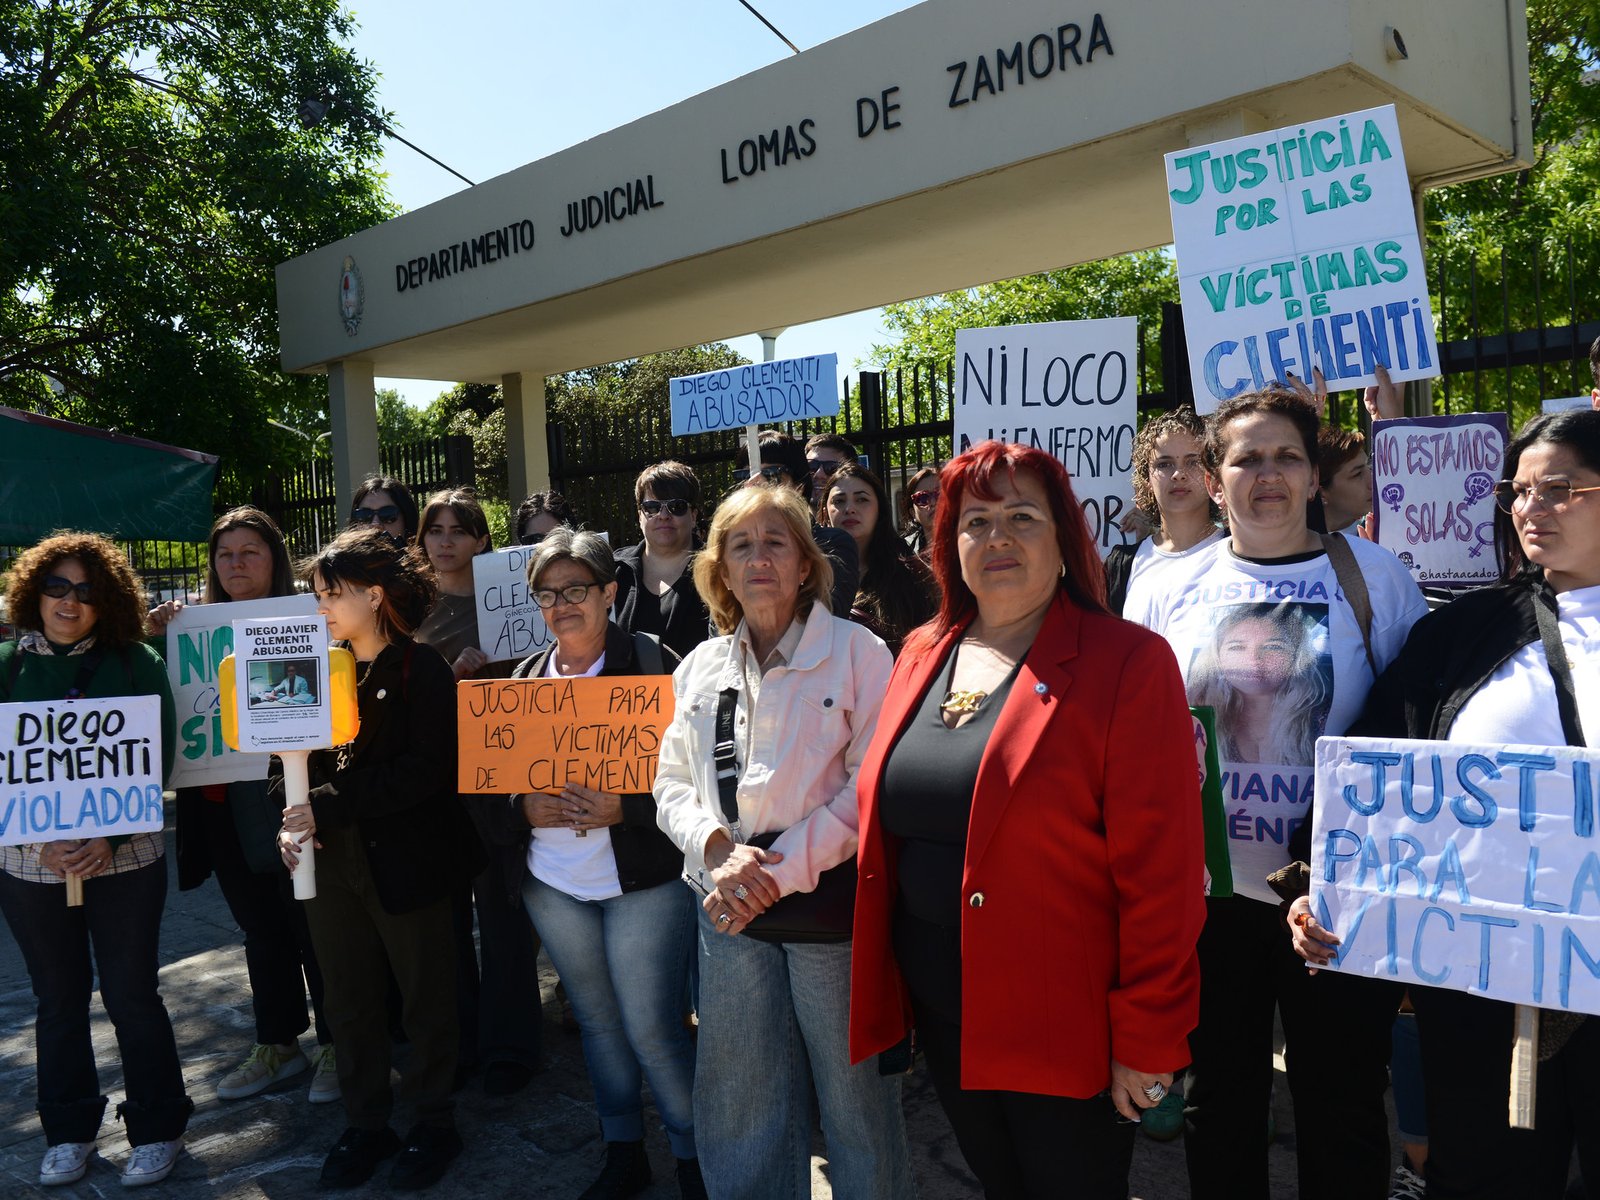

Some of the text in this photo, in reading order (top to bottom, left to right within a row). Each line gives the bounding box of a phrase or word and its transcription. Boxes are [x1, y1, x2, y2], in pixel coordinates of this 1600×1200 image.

[395, 13, 1114, 293] DEPARTAMENTO JUDICIAL LOMAS DE ZAMORA
[1214, 173, 1372, 236] POR LAS
[1284, 293, 1332, 321] DE
[679, 357, 820, 396] DIEGO CLEMENTI
[1021, 347, 1127, 407] LOCO
[687, 384, 821, 432] ABUSADOR
[1376, 428, 1501, 477] NO ESTAMOS
[1404, 501, 1473, 545] SOLAS
[1184, 579, 1330, 606] JUSTICIA
[245, 624, 318, 636] DIEGO JAVIER
[254, 635, 310, 646] CLEMENTI
[252, 645, 313, 656] ABUSADOR
[608, 685, 660, 715] PARA
[17, 707, 126, 747] Diego
[484, 723, 515, 750] LAS
[475, 767, 498, 791] DE
[1342, 751, 1600, 838] JUSTI
[1323, 828, 1473, 906] PARA
